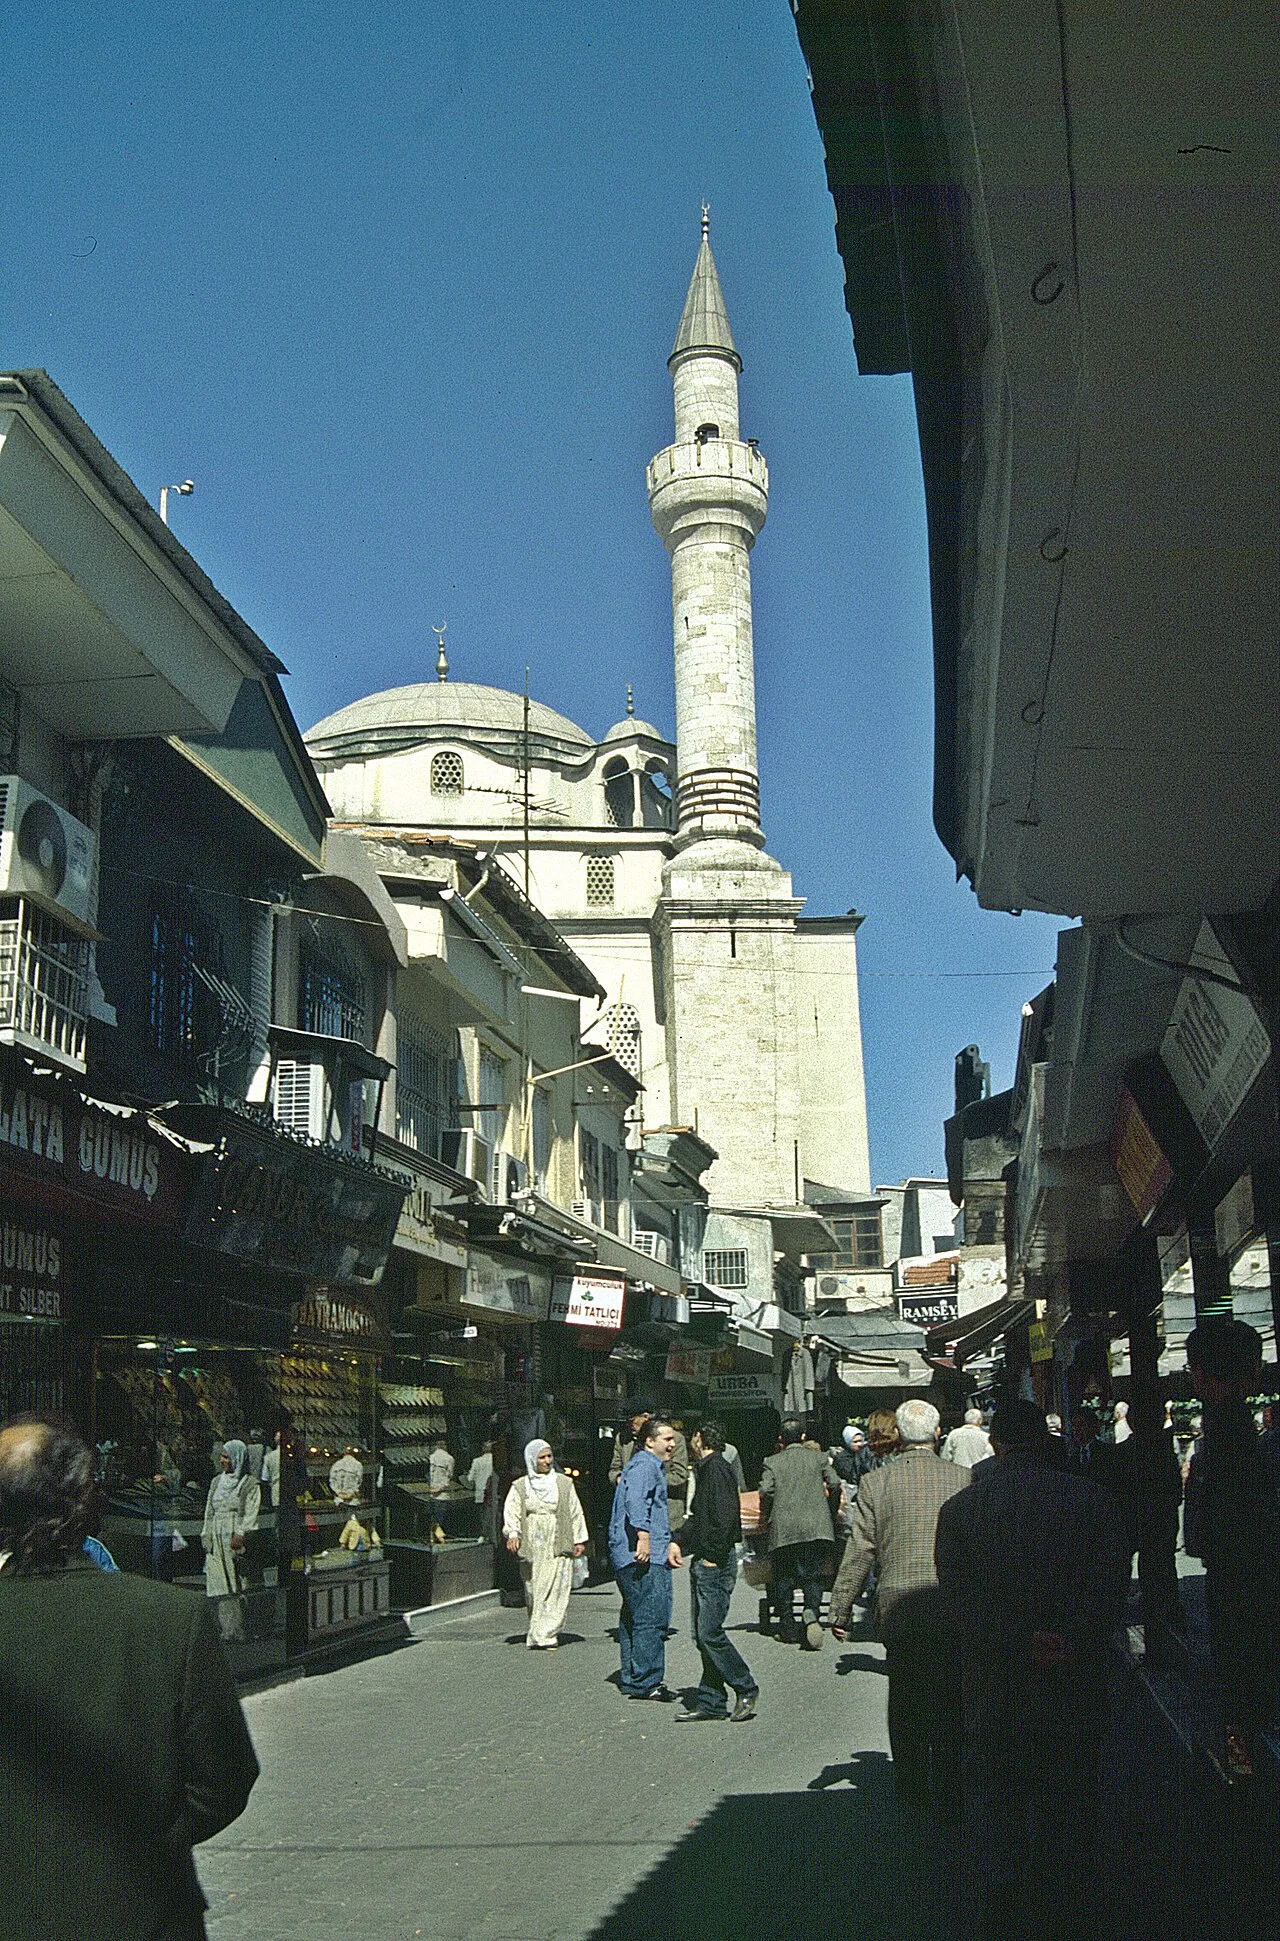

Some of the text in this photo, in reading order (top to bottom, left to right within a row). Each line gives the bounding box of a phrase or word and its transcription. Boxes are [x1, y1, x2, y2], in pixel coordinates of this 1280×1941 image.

[0, 1221, 61, 1279] ÜMÜŞ
[585, 1306, 620, 1319] TATLICI
[903, 1305, 958, 1319] RAMSEY
